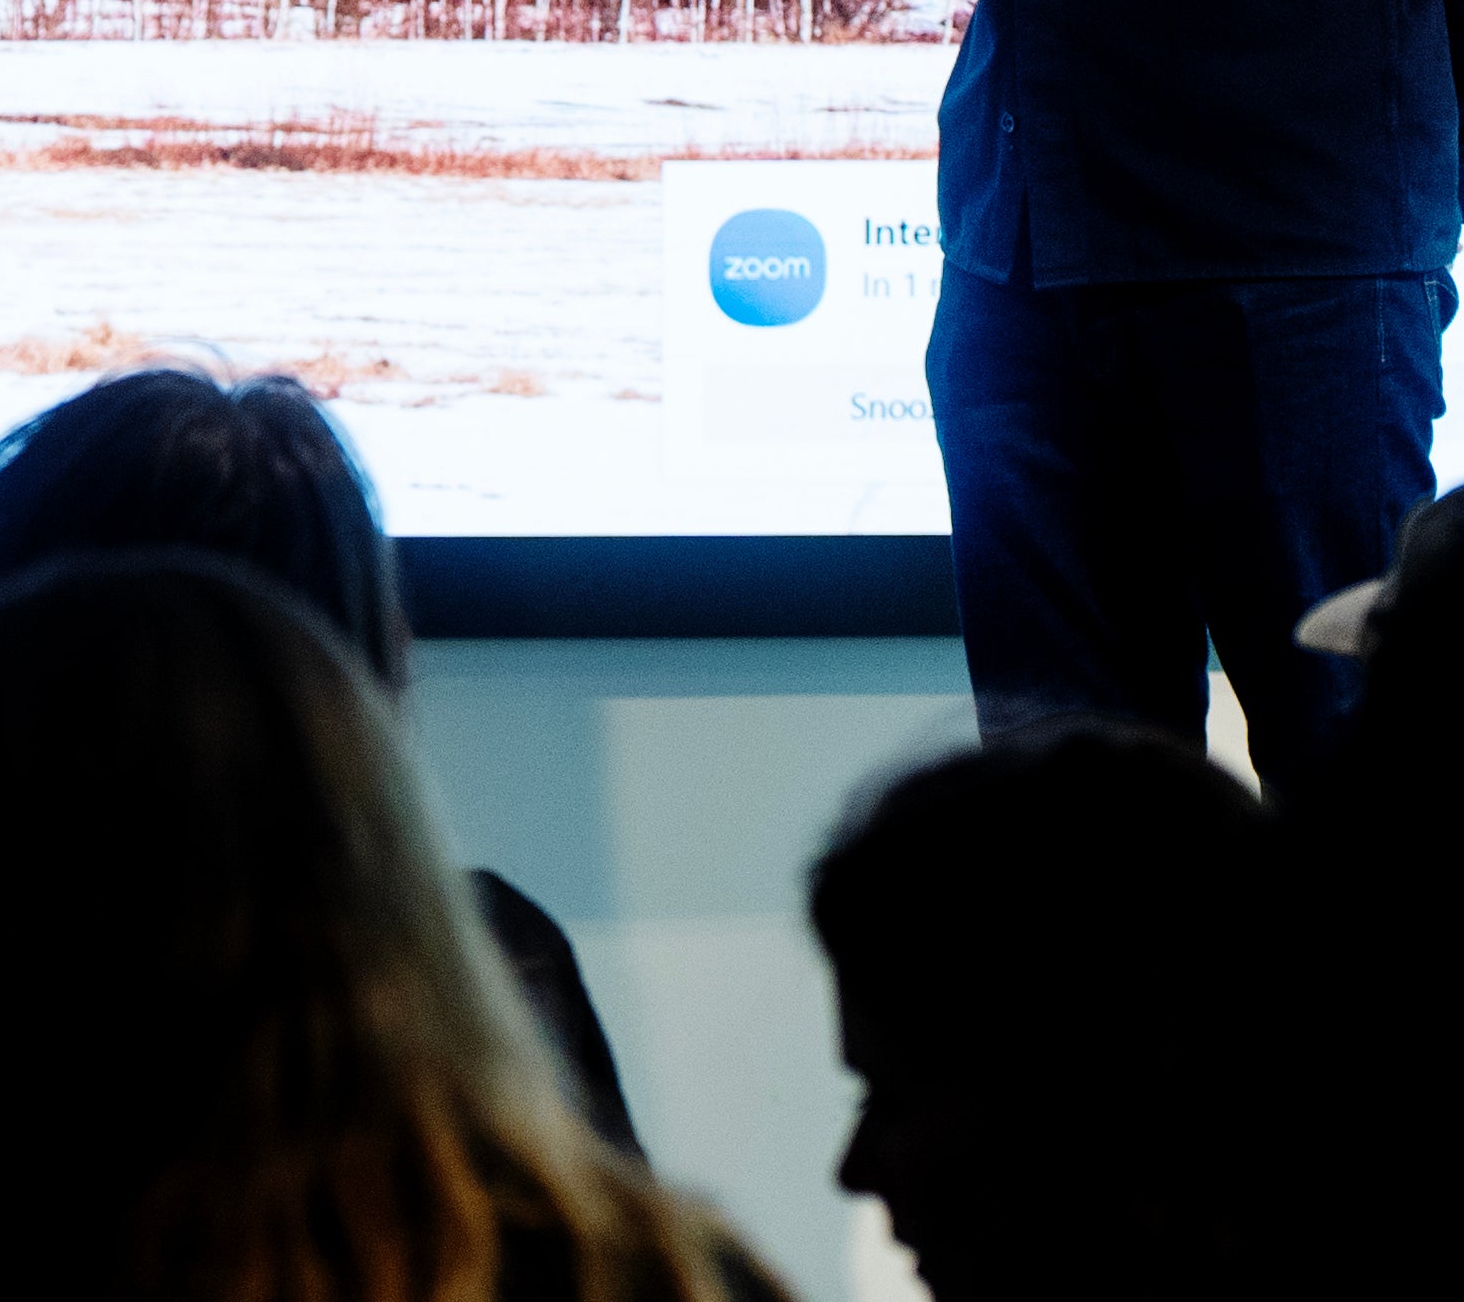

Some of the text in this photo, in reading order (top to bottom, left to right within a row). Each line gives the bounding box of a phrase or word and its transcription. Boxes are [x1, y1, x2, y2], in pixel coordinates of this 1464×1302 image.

[865, 218, 942, 245] Inte
[723, 255, 810, 281] zoom
[863, 272, 890, 297] In
[905, 272, 915, 297] 1
[851, 392, 934, 419] Snoo
